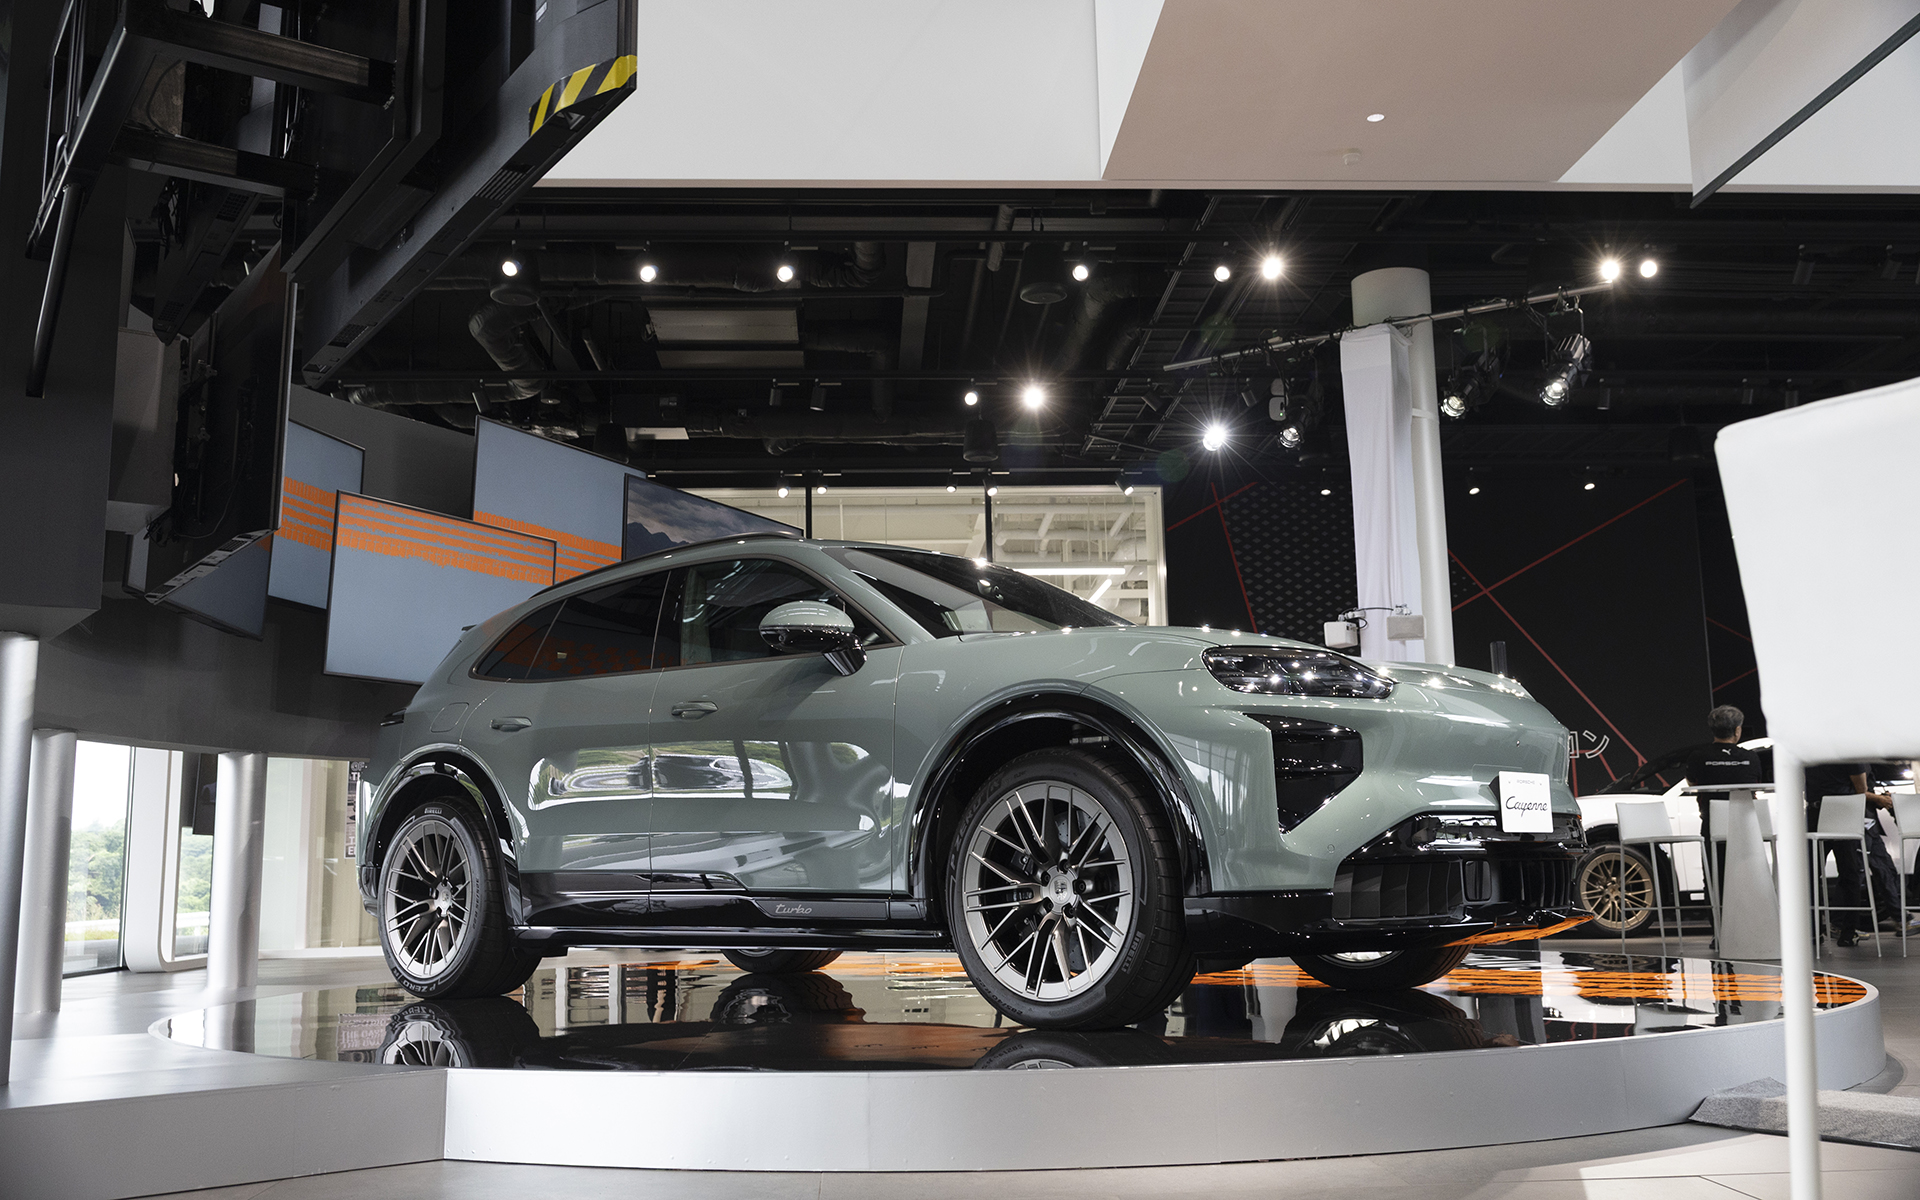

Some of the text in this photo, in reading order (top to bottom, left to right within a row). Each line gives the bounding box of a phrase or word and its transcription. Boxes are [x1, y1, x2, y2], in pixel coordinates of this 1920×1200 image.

[1505, 795, 1548, 818] Cayenne
[775, 903, 812, 914] turbo
[402, 979, 428, 993] ZERO
